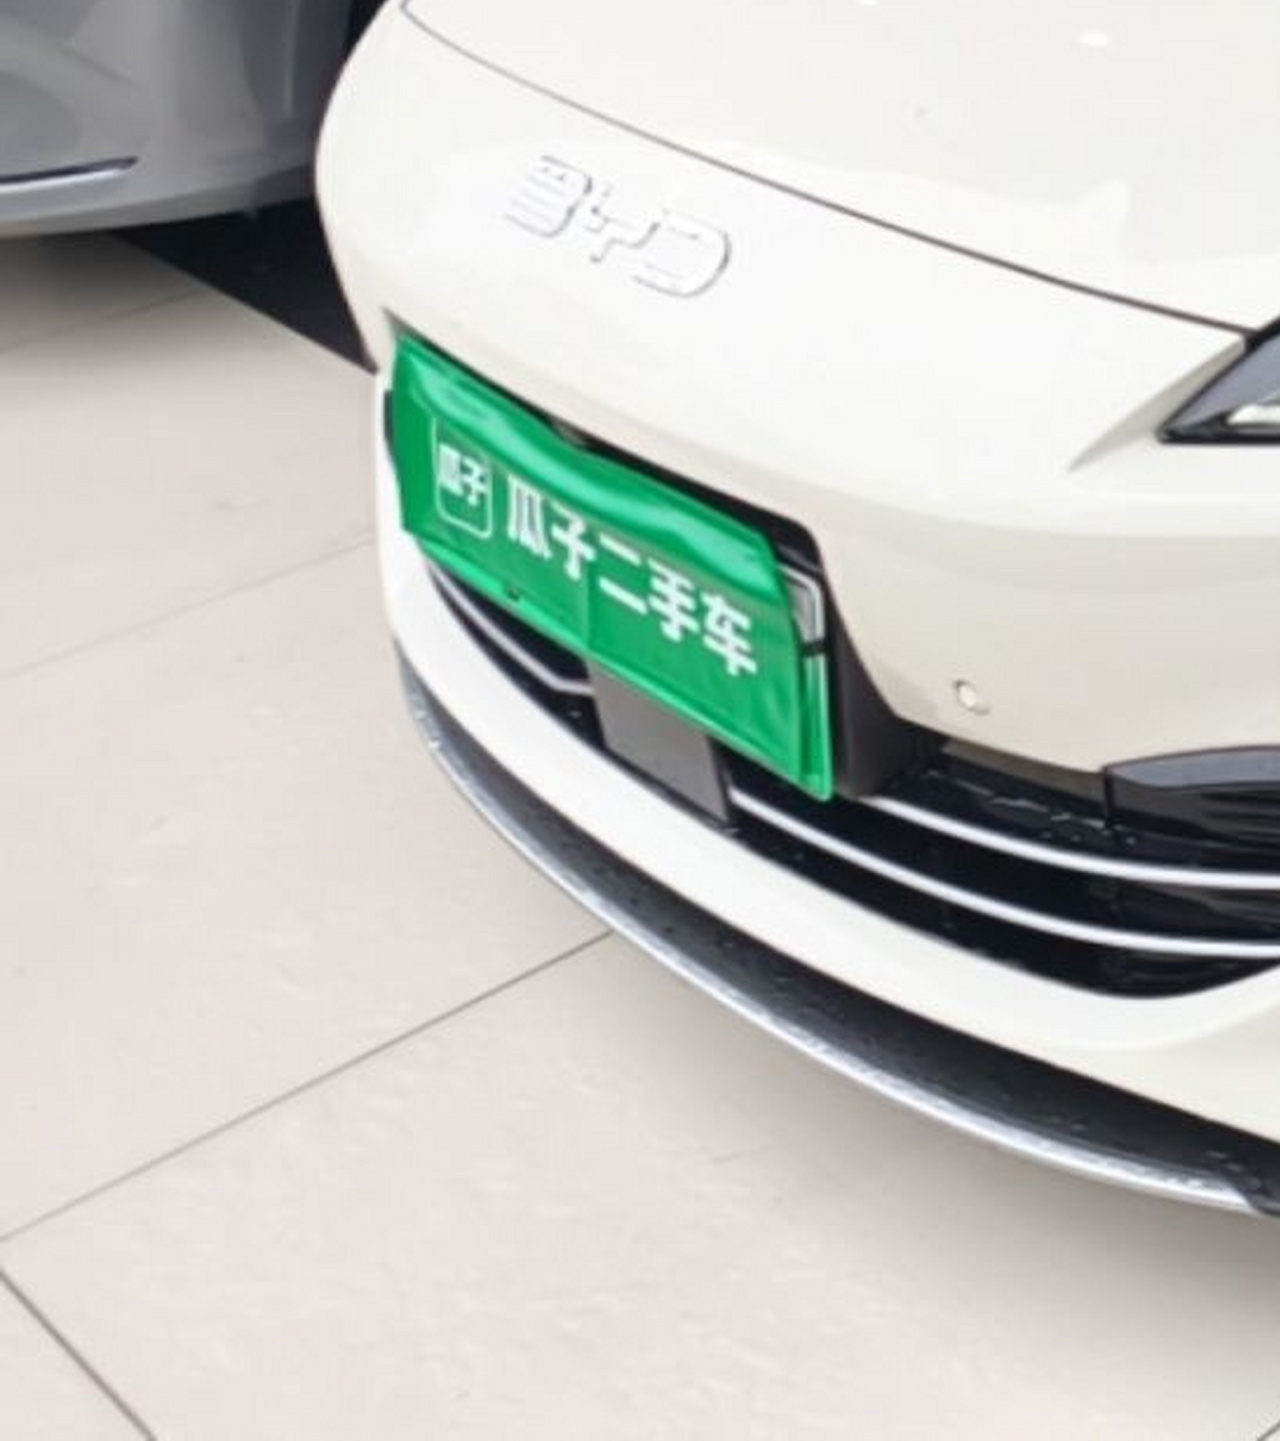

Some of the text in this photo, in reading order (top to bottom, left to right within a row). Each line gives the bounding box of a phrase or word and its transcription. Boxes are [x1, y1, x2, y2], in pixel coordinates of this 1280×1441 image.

[499, 154, 732, 299] BYD
[506, 472, 757, 677] 瓜子二手车
